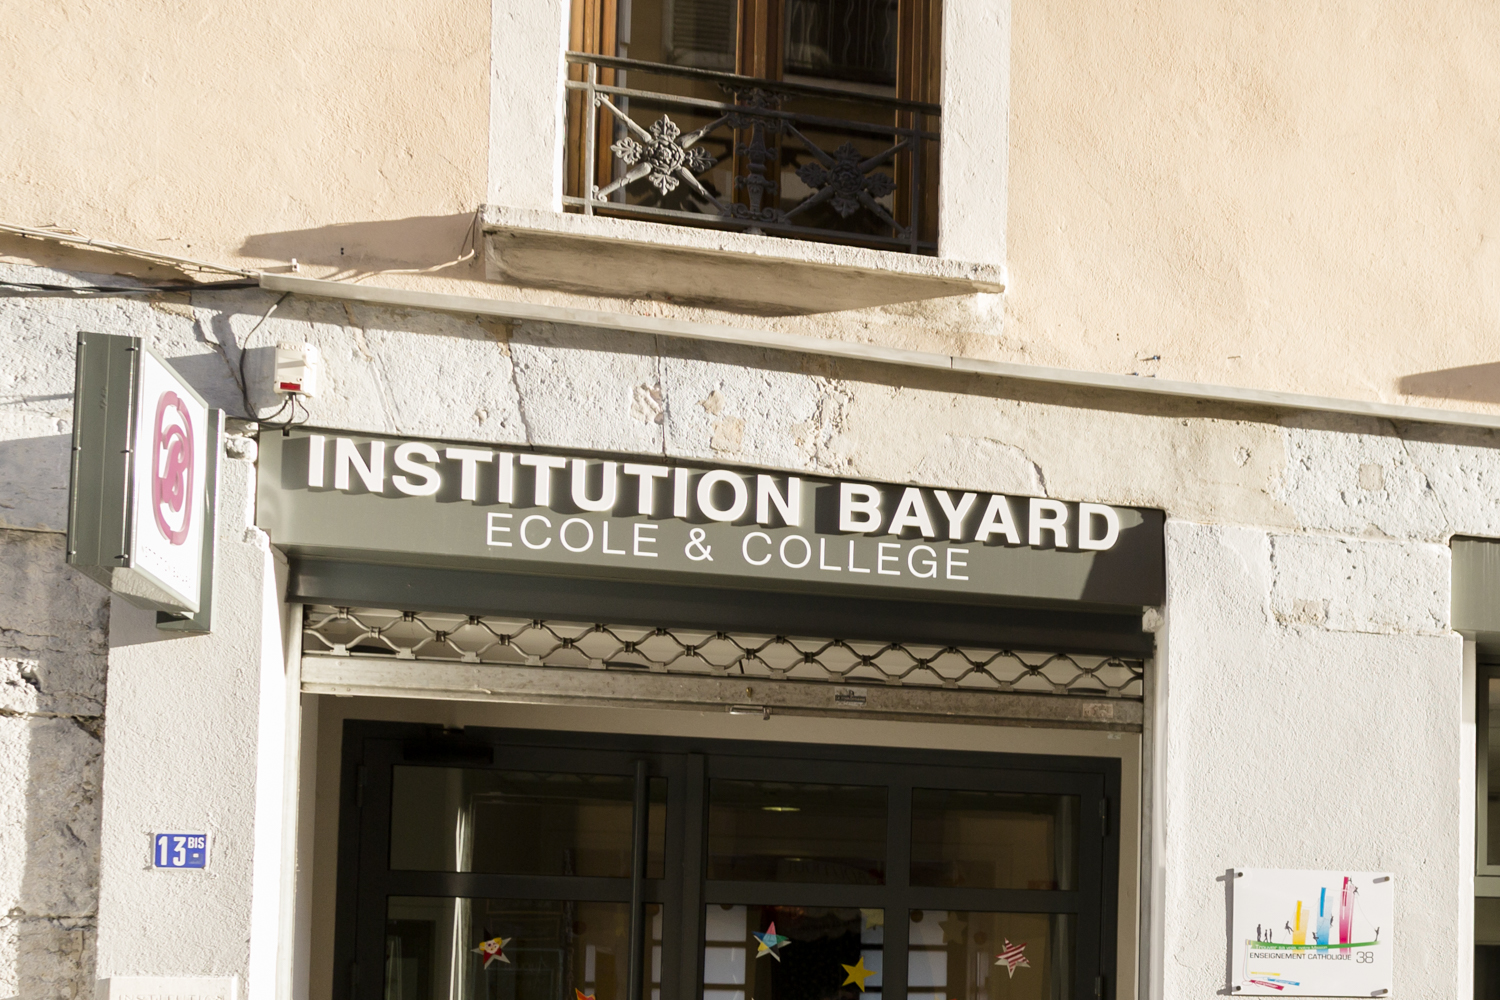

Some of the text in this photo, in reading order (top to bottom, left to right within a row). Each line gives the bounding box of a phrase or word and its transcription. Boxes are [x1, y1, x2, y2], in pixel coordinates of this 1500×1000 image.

[307, 435, 1121, 552] INSTITUTION BAYARD
[485, 512, 970, 581] ECOLE & COLLEGE
[158, 836, 205, 866] 13 BIS
[1250, 951, 1374, 964] ENSEIGNEMENT CATHOLIQUE 38
